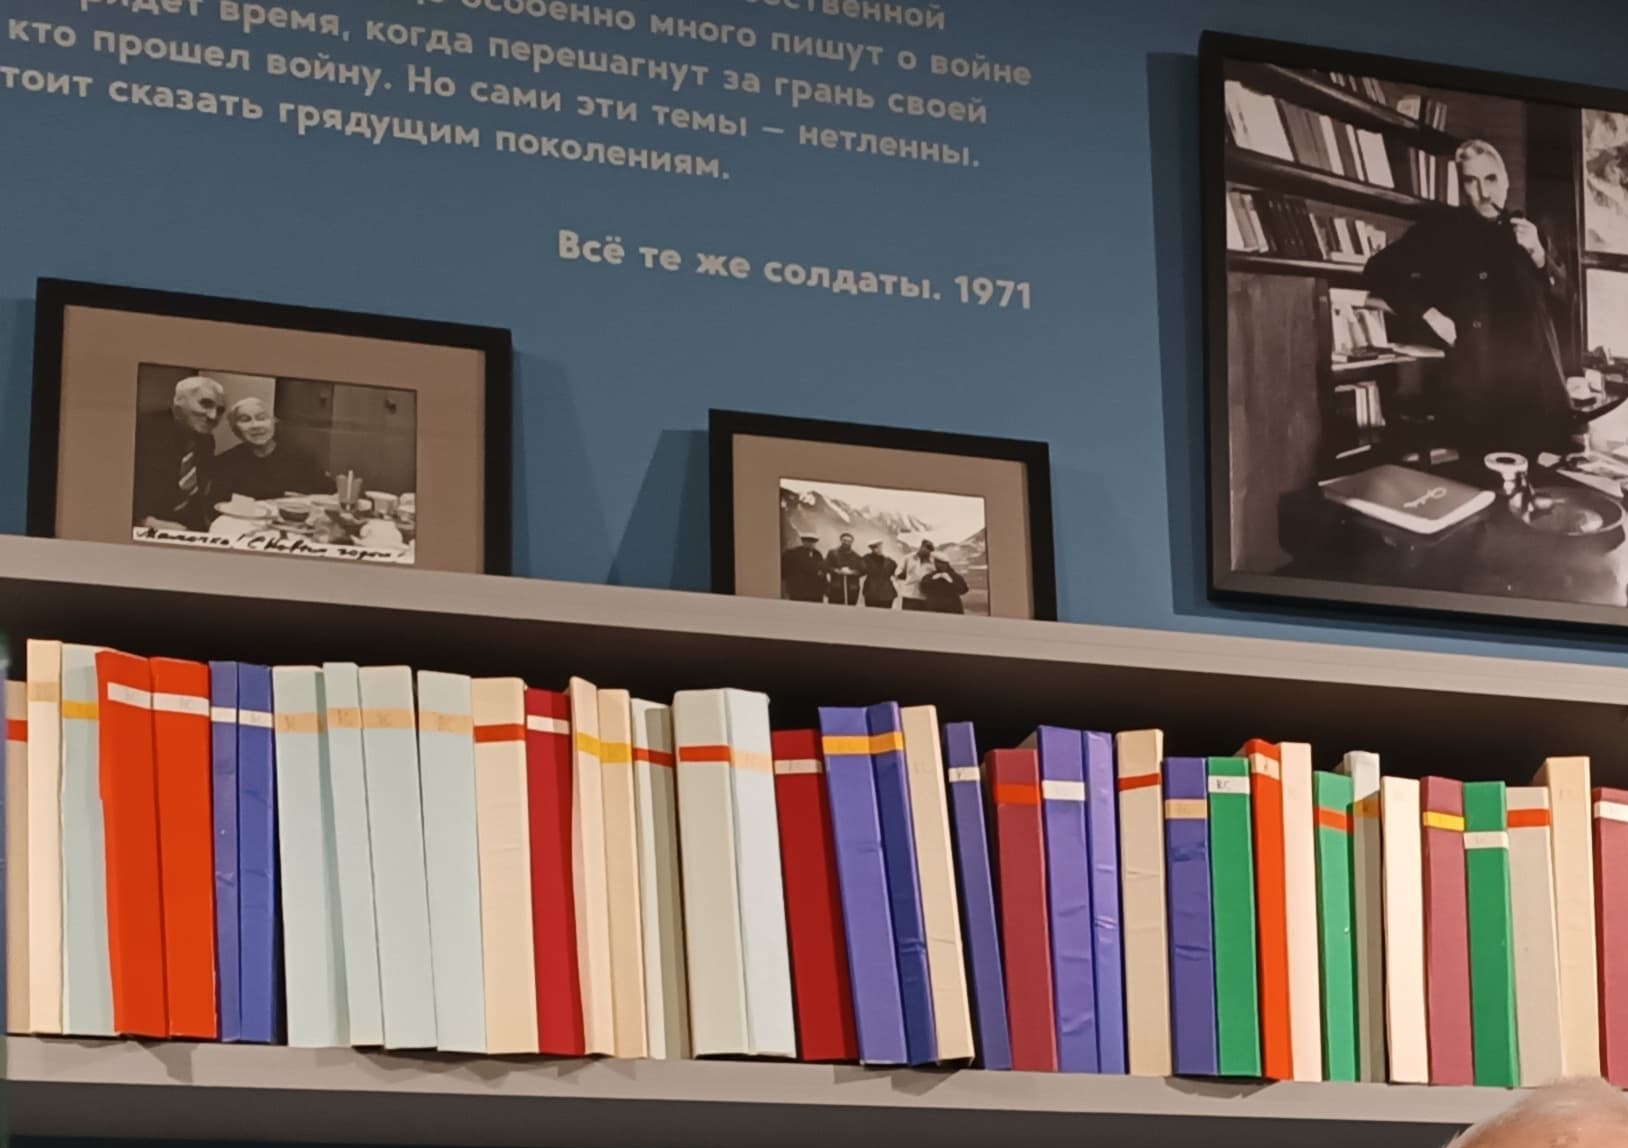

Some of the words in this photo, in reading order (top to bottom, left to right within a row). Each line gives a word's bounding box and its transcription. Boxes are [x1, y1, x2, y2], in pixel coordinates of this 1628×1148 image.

[650, 14, 757, 47] много
[771, 32, 883, 71] пишут
[897, 51, 918, 70] о
[930, 54, 1032, 86] войне
[745, 0, 945, 30] ственной
[8, 18, 77, 47] кто
[93, 30, 250, 71] прошел
[266, 52, 392, 97] войну.
[408, 64, 456, 96] Но
[470, 80, 562, 111] сами
[577, 95, 638, 121] эти
[653, 104, 749, 136] темы
[799, 125, 981, 168] нетленны.
[219, 0, 350, 41] время,
[366, 20, 473, 54] когда
[489, 37, 709, 90] перешагнут
[723, 69, 761, 94] за
[774, 77, 876, 108] грань
[888, 92, 987, 124] своей
[108, 80, 265, 120] сказать
[279, 101, 481, 147] грядущим
[496, 129, 731, 180] поколениям.
[557, 228, 625, 265] Всё
[638, 244, 682, 271] те
[696, 251, 751, 279] же
[763, 259, 942, 301] солдаты.
[953, 273, 1033, 309] 1971
